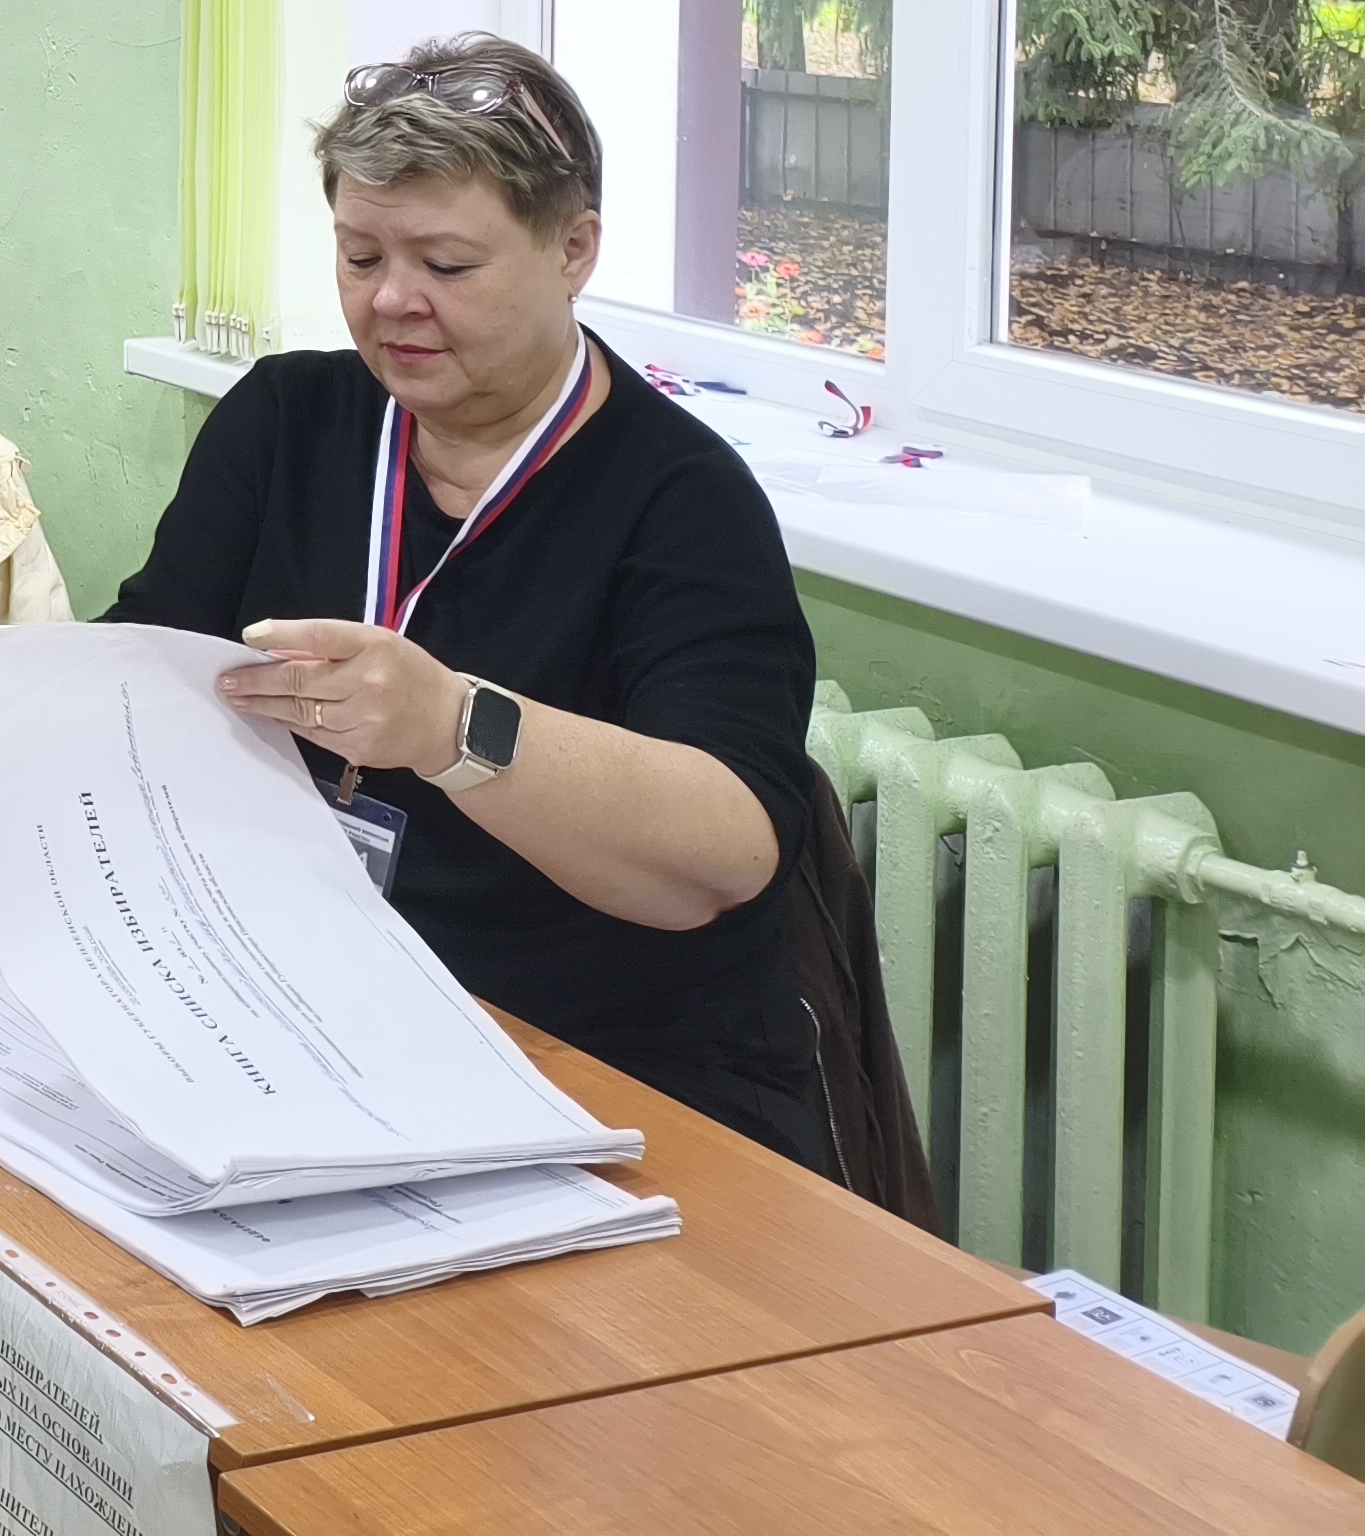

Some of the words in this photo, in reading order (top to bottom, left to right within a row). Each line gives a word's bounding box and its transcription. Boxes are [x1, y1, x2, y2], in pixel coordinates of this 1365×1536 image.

[36, 824, 58, 886] ОБЛАСТИ
[77, 790, 155, 954] ИЗБИРАТЕЛЕЙ
[53, 889, 98, 972] ПЕНЗЕНСКОЙ
[96, 972, 156, 1040] ГУБЕРНАТОРА
[152, 958, 219, 1031] СПИСКА
[153, 1040, 195, 1084] ВЫБОРЫ
[218, 1034, 277, 1096] КНИГА
[0, 1334, 103, 1441] ИЗБИРАТЕЛЕЙ,
[4, 1412, 54, 1465] МЕСТУ
[55, 1457, 143, 1536] НАХОЖДЕН
[19, 1394, 39, 1422] НА
[41, 1411, 134, 1503] ОСНОВАНИИ
